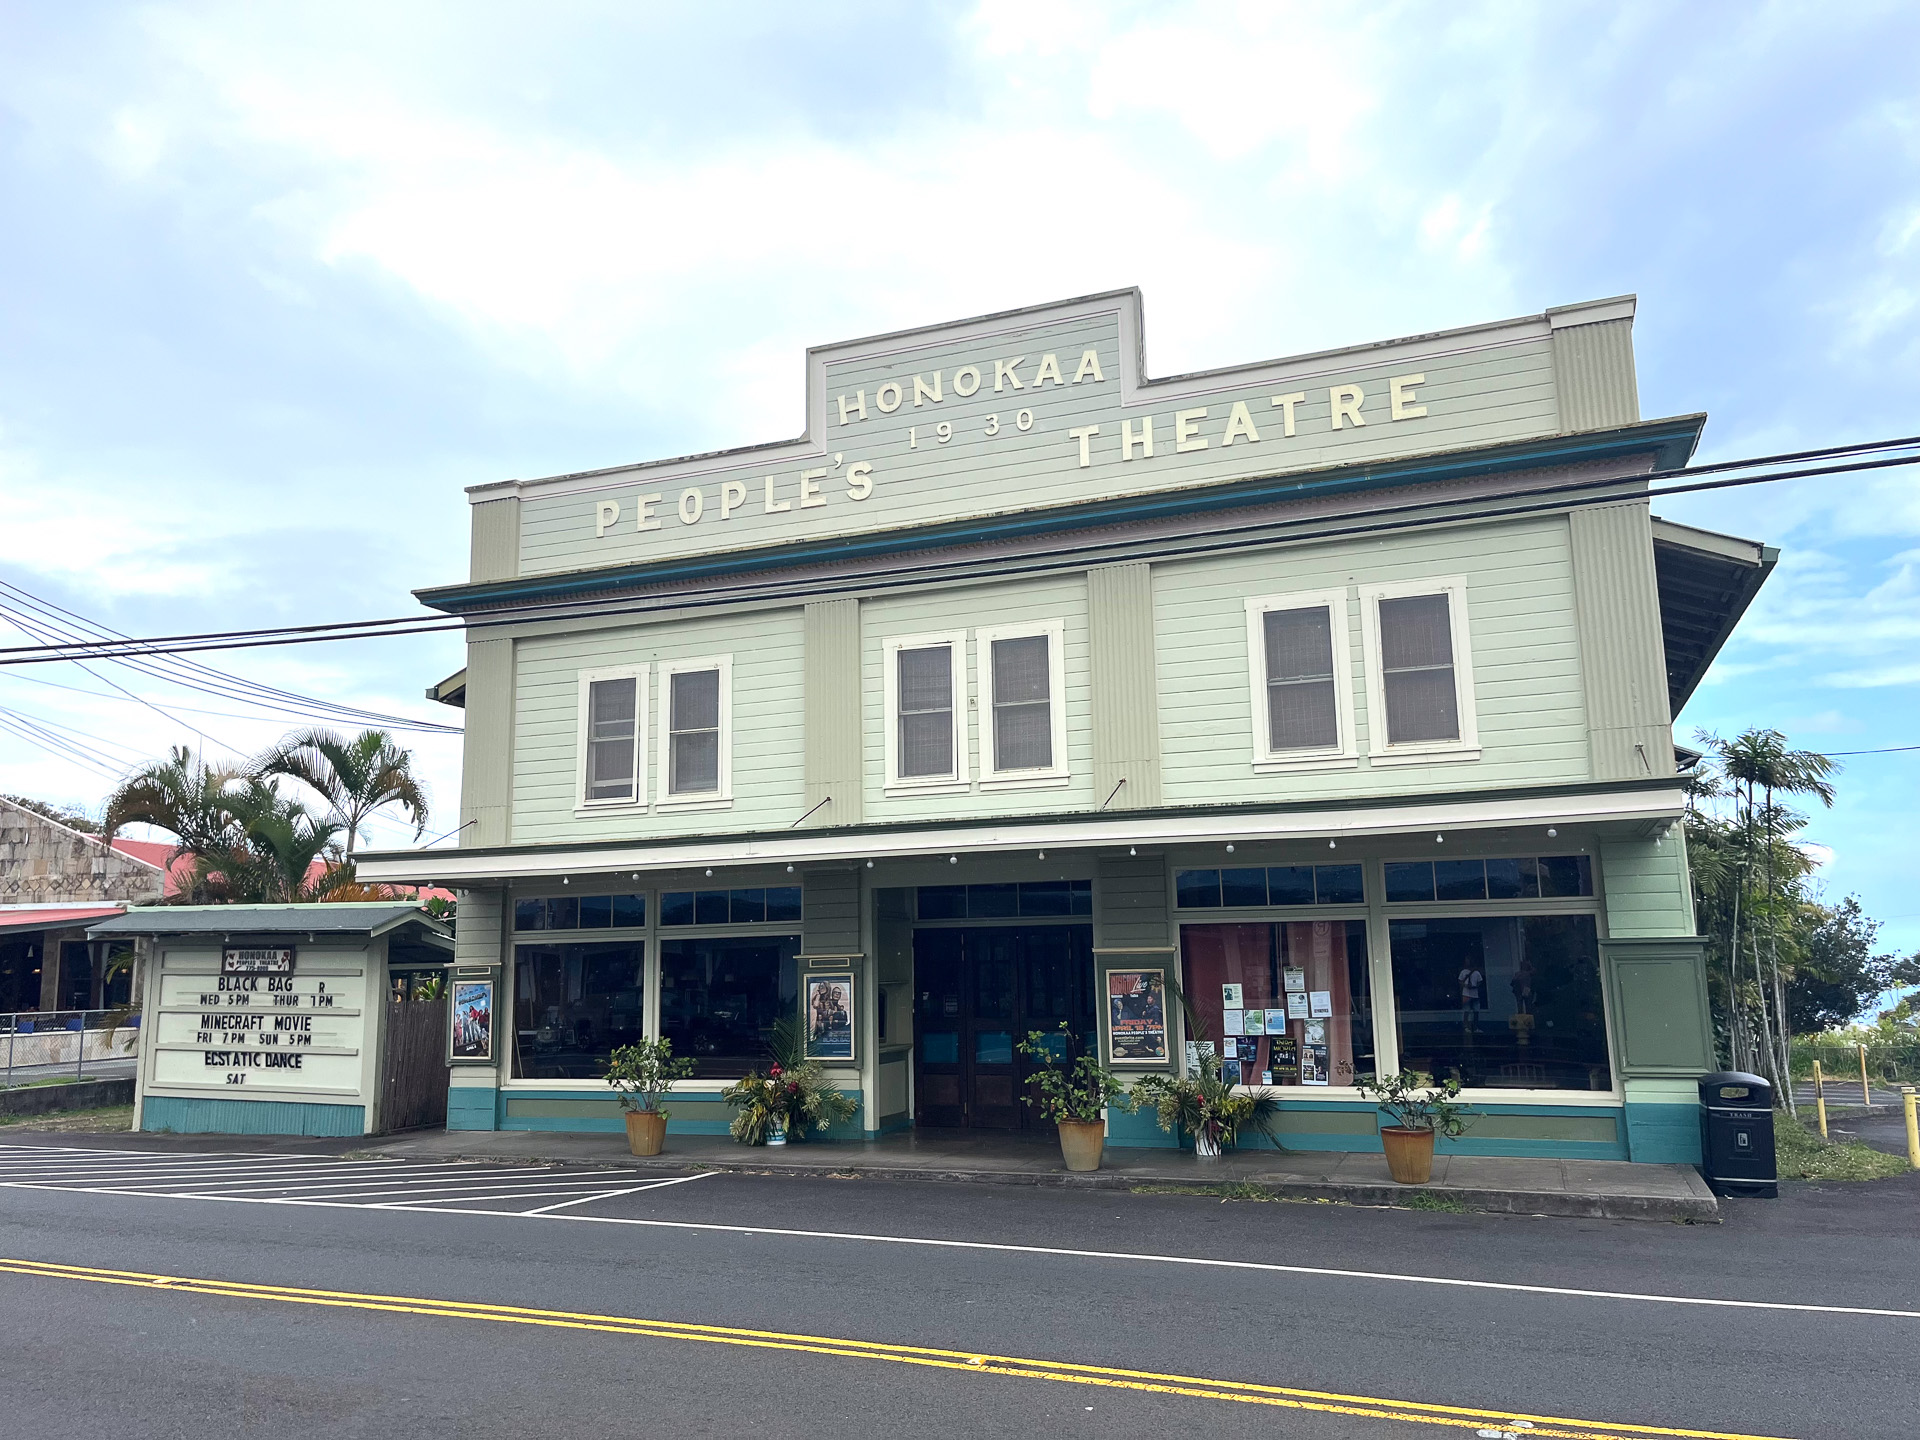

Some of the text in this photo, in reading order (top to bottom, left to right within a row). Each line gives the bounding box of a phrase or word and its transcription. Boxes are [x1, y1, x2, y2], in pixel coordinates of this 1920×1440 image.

[837, 350, 1104, 425] HONOKAA
[909, 408, 1034, 448] 1930
[596, 373, 1427, 538] PEOPLE'S THEATRE
[238, 951, 278, 960] HONOKAA
[218, 977, 325, 993] BLACK BAG R
[200, 994, 220, 1005] WED
[273, 995, 298, 1006] THUR
[201, 1014, 312, 1031] MINECRAFT MOVIE
[197, 1032, 212, 1043] FRI
[259, 1034, 278, 1045] SUN
[205, 1051, 302, 1068] ECSTATIC DANCE
[226, 1073, 246, 1084] SAT
